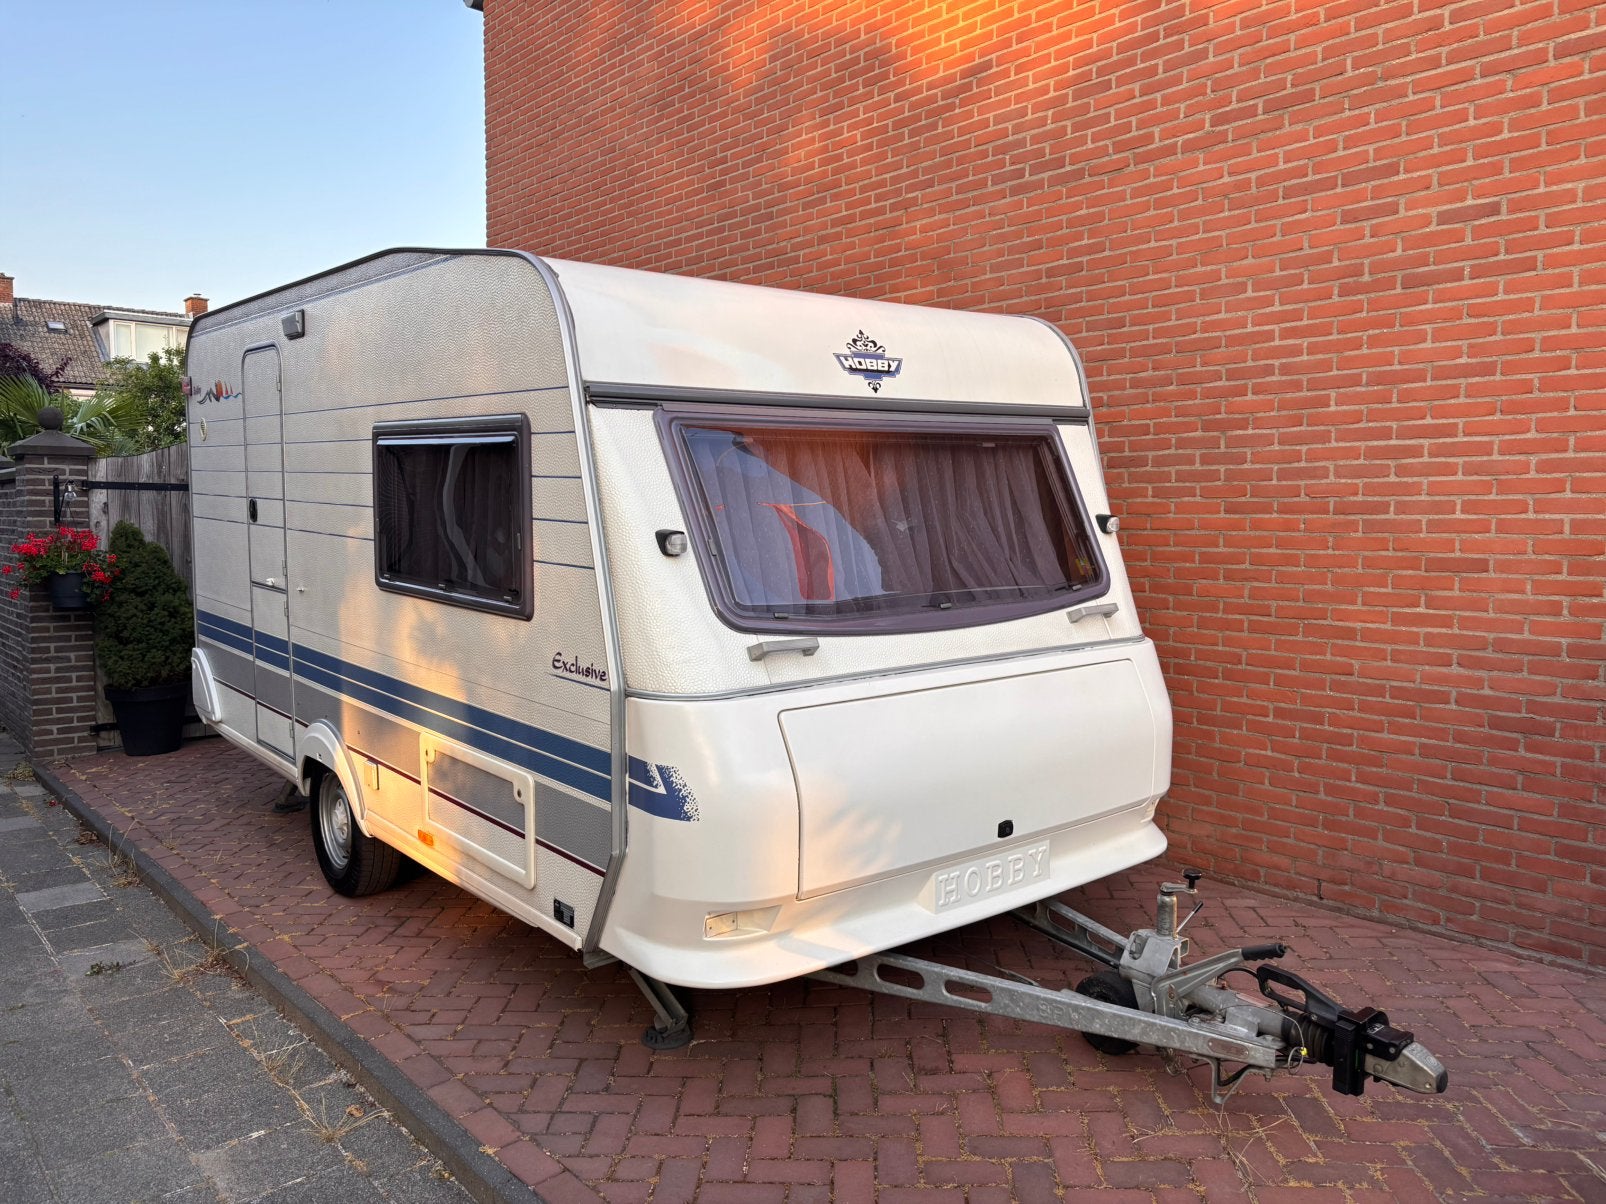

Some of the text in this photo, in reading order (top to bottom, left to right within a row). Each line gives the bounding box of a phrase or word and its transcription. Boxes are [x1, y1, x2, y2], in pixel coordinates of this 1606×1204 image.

[839, 356, 900, 373] HOBBY
[552, 651, 608, 682] Exclusive
[938, 846, 1048, 907] HOBBY
